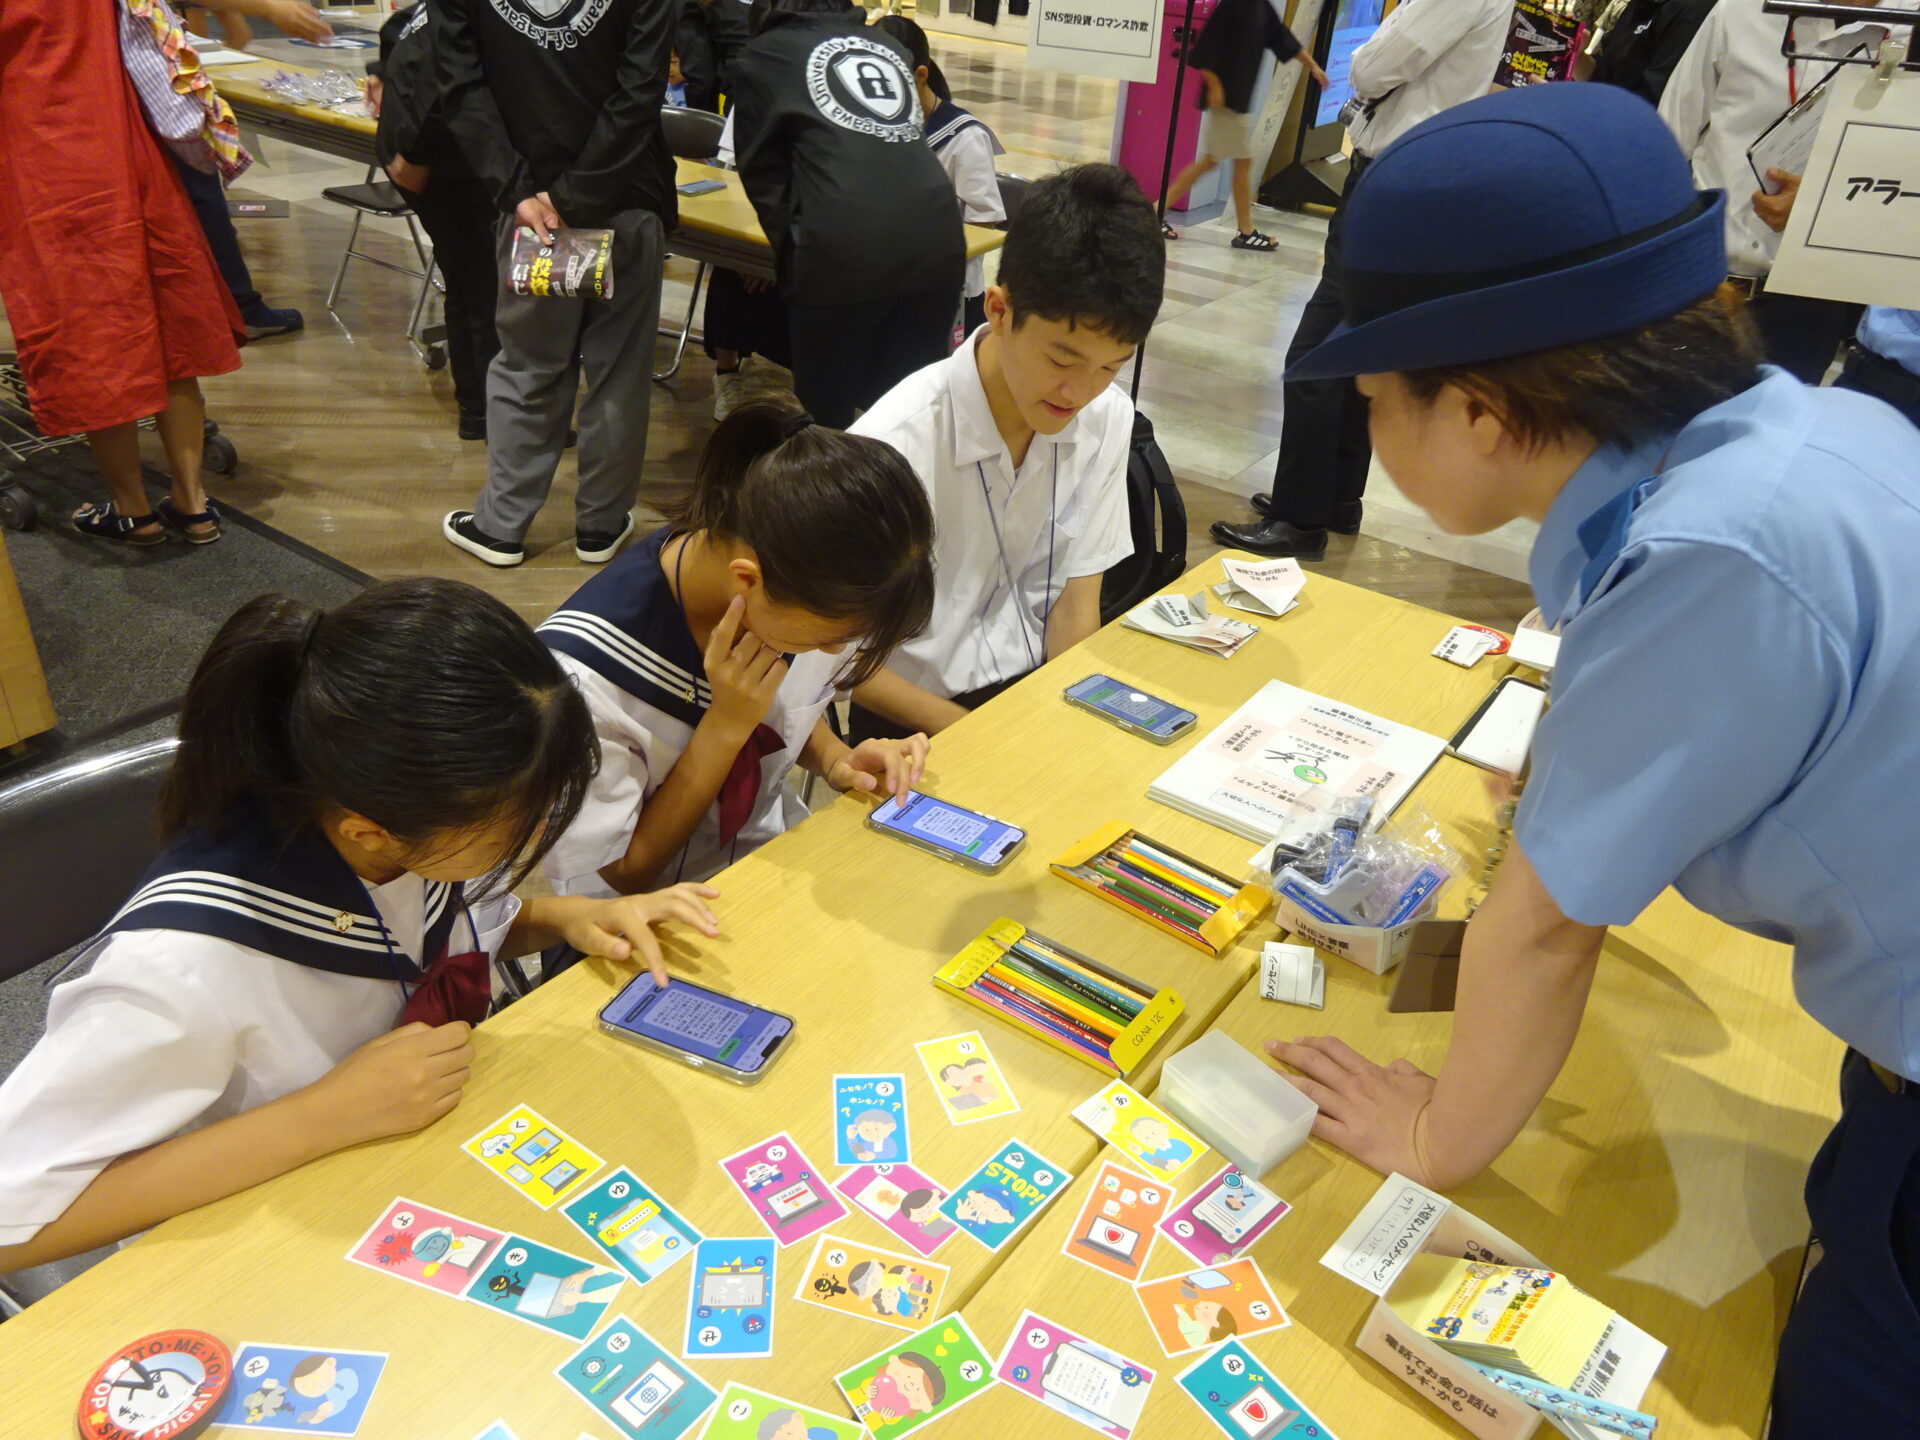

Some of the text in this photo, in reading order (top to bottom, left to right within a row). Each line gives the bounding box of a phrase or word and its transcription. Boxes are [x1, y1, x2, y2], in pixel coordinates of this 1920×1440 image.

[491, 0, 548, 48] Kagaw
[555, 30, 578, 50] Of
[1045, 11, 1149, 32] SNS型投資・ロマンス詐欺
[812, 39, 847, 106] University
[831, 105, 899, 142] Kagawa
[984, 1161, 1048, 1208] STOP!
[1374, 1203, 1437, 1282] 大切な人へのメッセージ
[1385, 1332, 1500, 1421] 電話でお金の話は
[1405, 1364, 1465, 1414] サギ・かも
[154, 1393, 214, 1439] HIGAI
